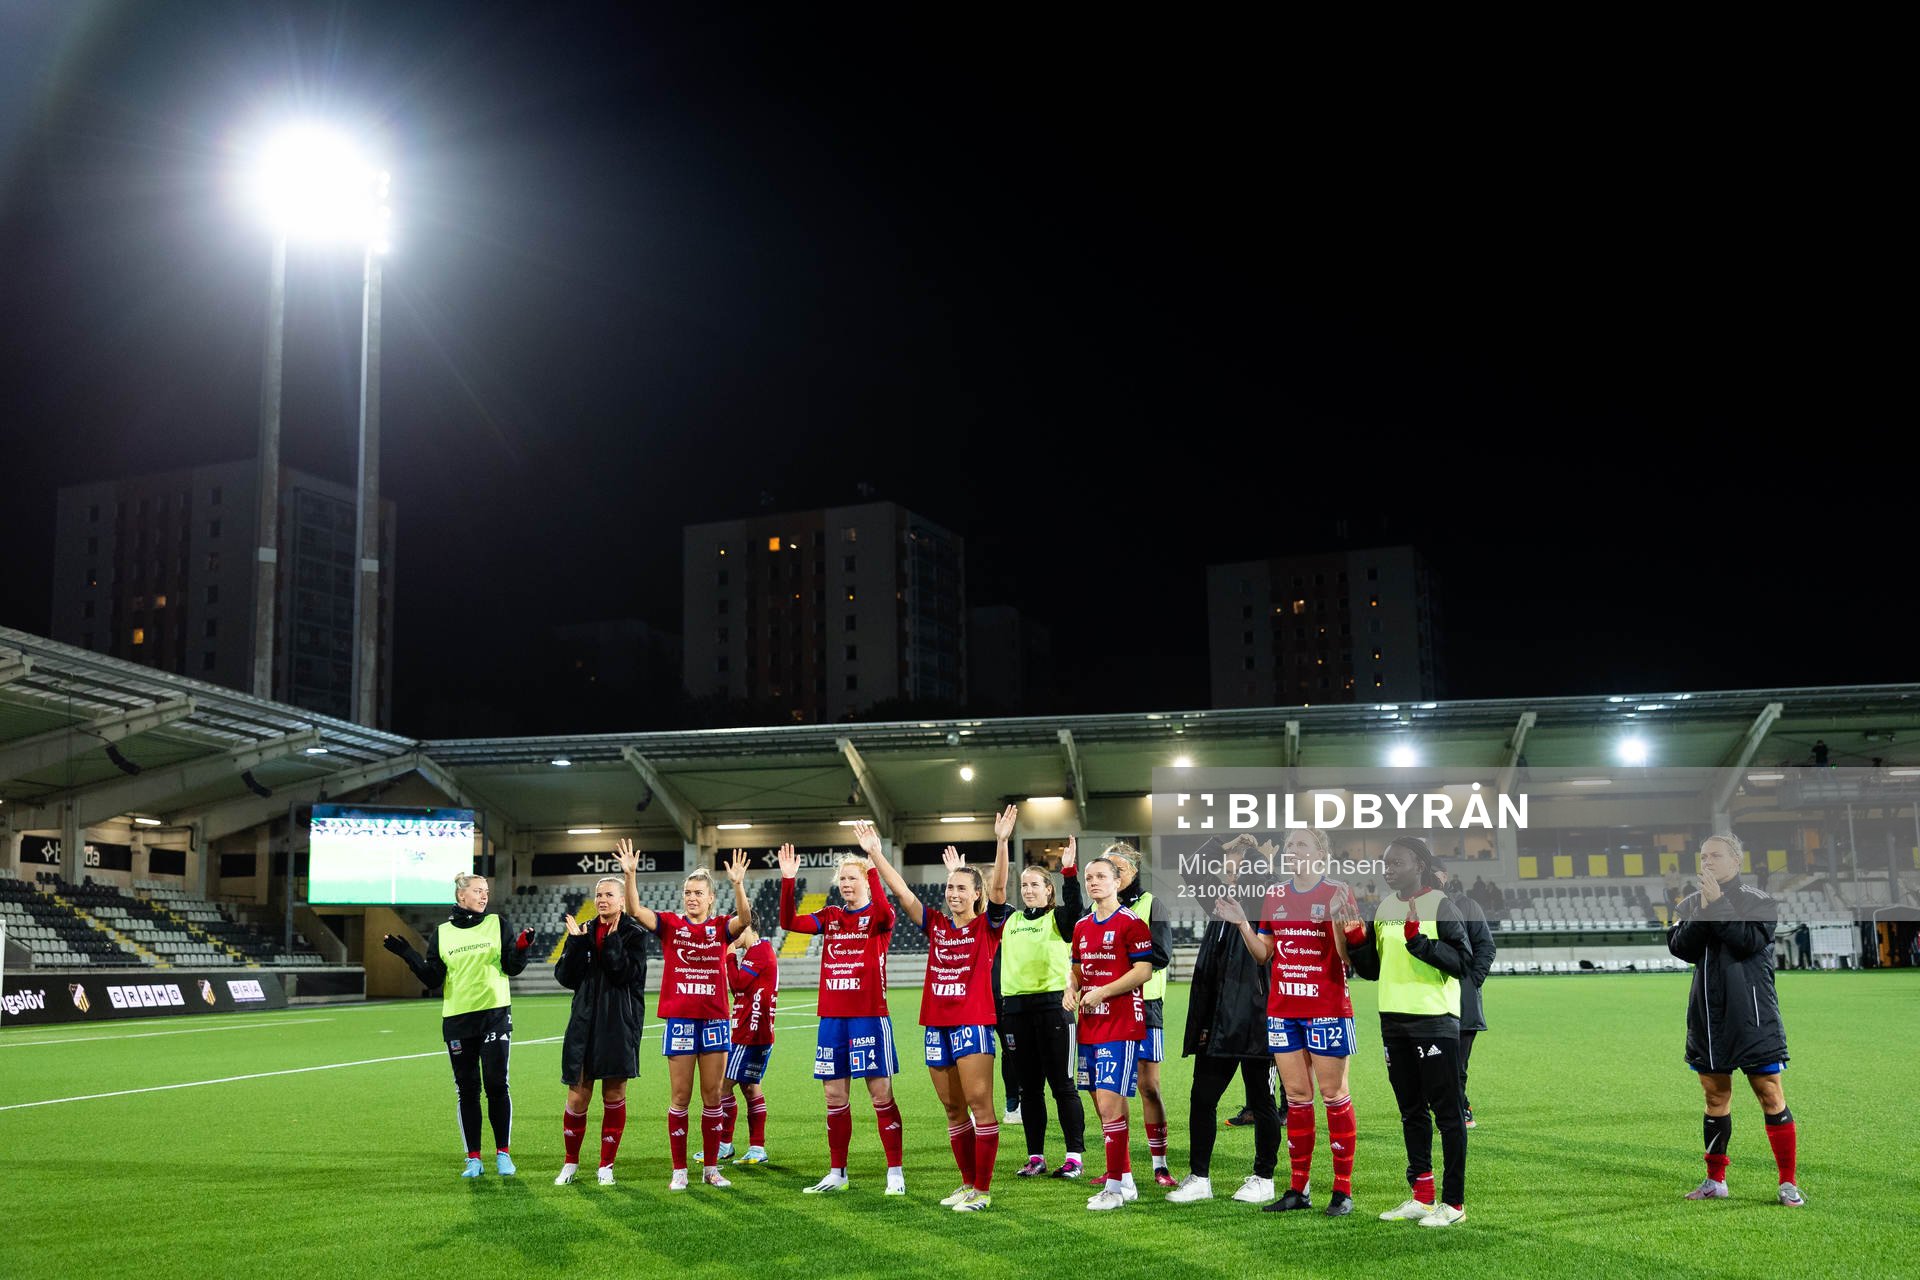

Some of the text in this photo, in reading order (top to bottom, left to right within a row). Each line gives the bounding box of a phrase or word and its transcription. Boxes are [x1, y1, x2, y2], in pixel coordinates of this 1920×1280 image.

[595, 854, 656, 872] brada
[676, 982, 716, 996] NIBE
[826, 978, 860, 990] NIBE
[931, 982, 966, 996] NIBE
[1278, 981, 1319, 997] NIBE
[111, 988, 181, 1005] CRAMO
[484, 1031, 497, 1043] 23
[962, 1026, 972, 1039] 10
[1327, 1026, 1343, 1040] 22
[852, 1036, 876, 1046] FASAB
[868, 1049, 876, 1060] 4
[1417, 1046, 1425, 1059] 3
[1105, 1060, 1118, 1073] 17
